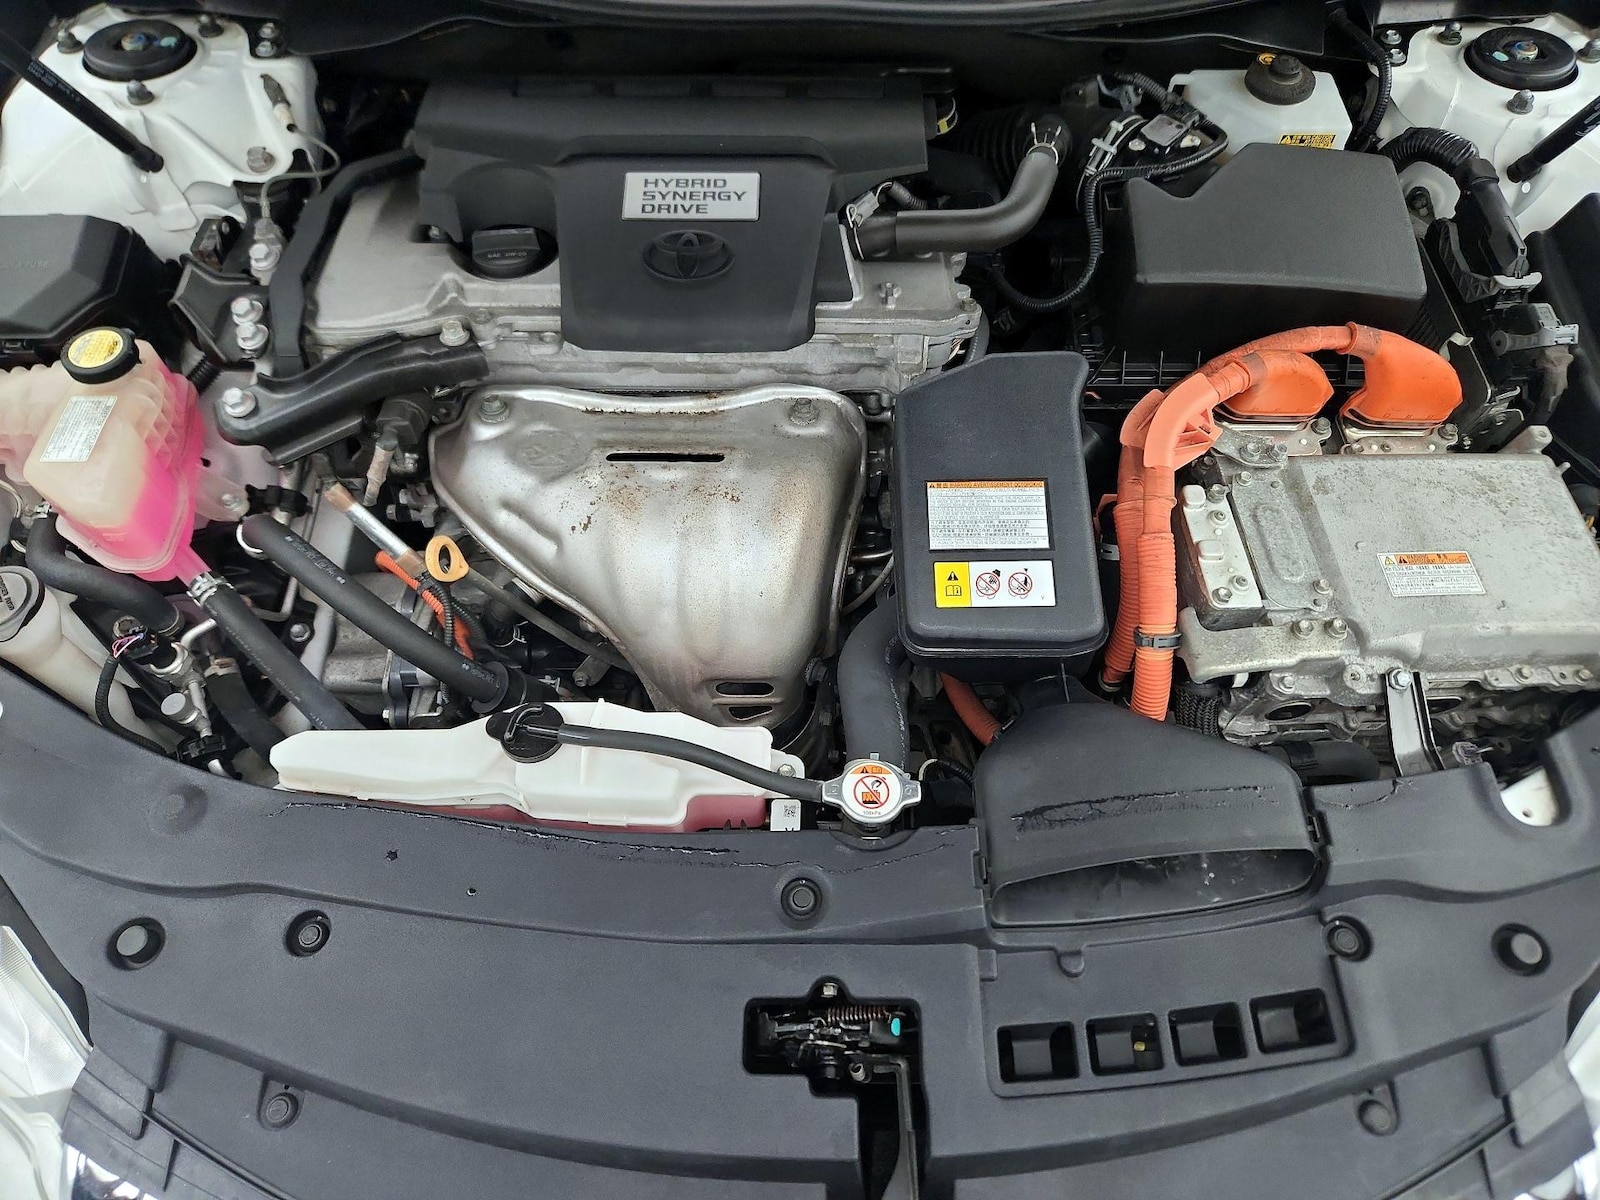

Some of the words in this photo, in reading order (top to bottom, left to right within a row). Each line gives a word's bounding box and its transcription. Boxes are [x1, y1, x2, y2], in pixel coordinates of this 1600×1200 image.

[643, 178, 728, 189] HYBRID
[642, 190, 747, 202] SYNERGY
[641, 203, 709, 215] DRIVE
